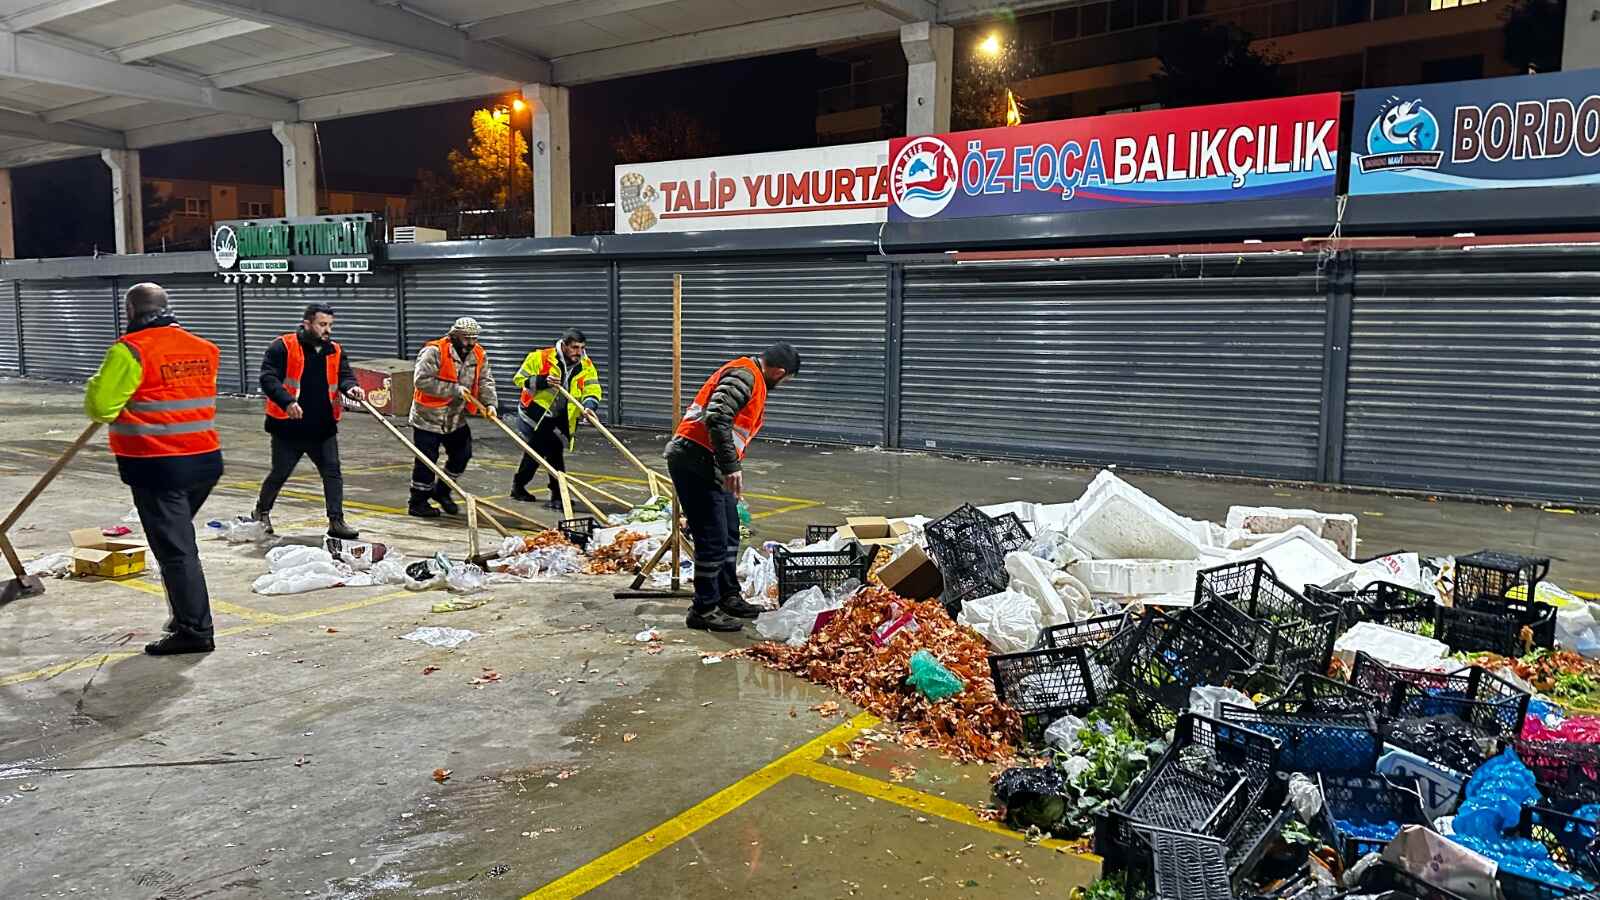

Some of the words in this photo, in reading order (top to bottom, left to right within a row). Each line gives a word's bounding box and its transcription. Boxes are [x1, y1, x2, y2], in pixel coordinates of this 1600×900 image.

[962, 140, 1006, 196] ÖZ
[1013, 139, 1106, 200] FOÇA
[1112, 119, 1336, 188] BALIKÇILIK
[1452, 95, 1600, 163] BORDO
[660, 171, 736, 212] TALİP
[743, 165, 888, 207] YUMURTA
